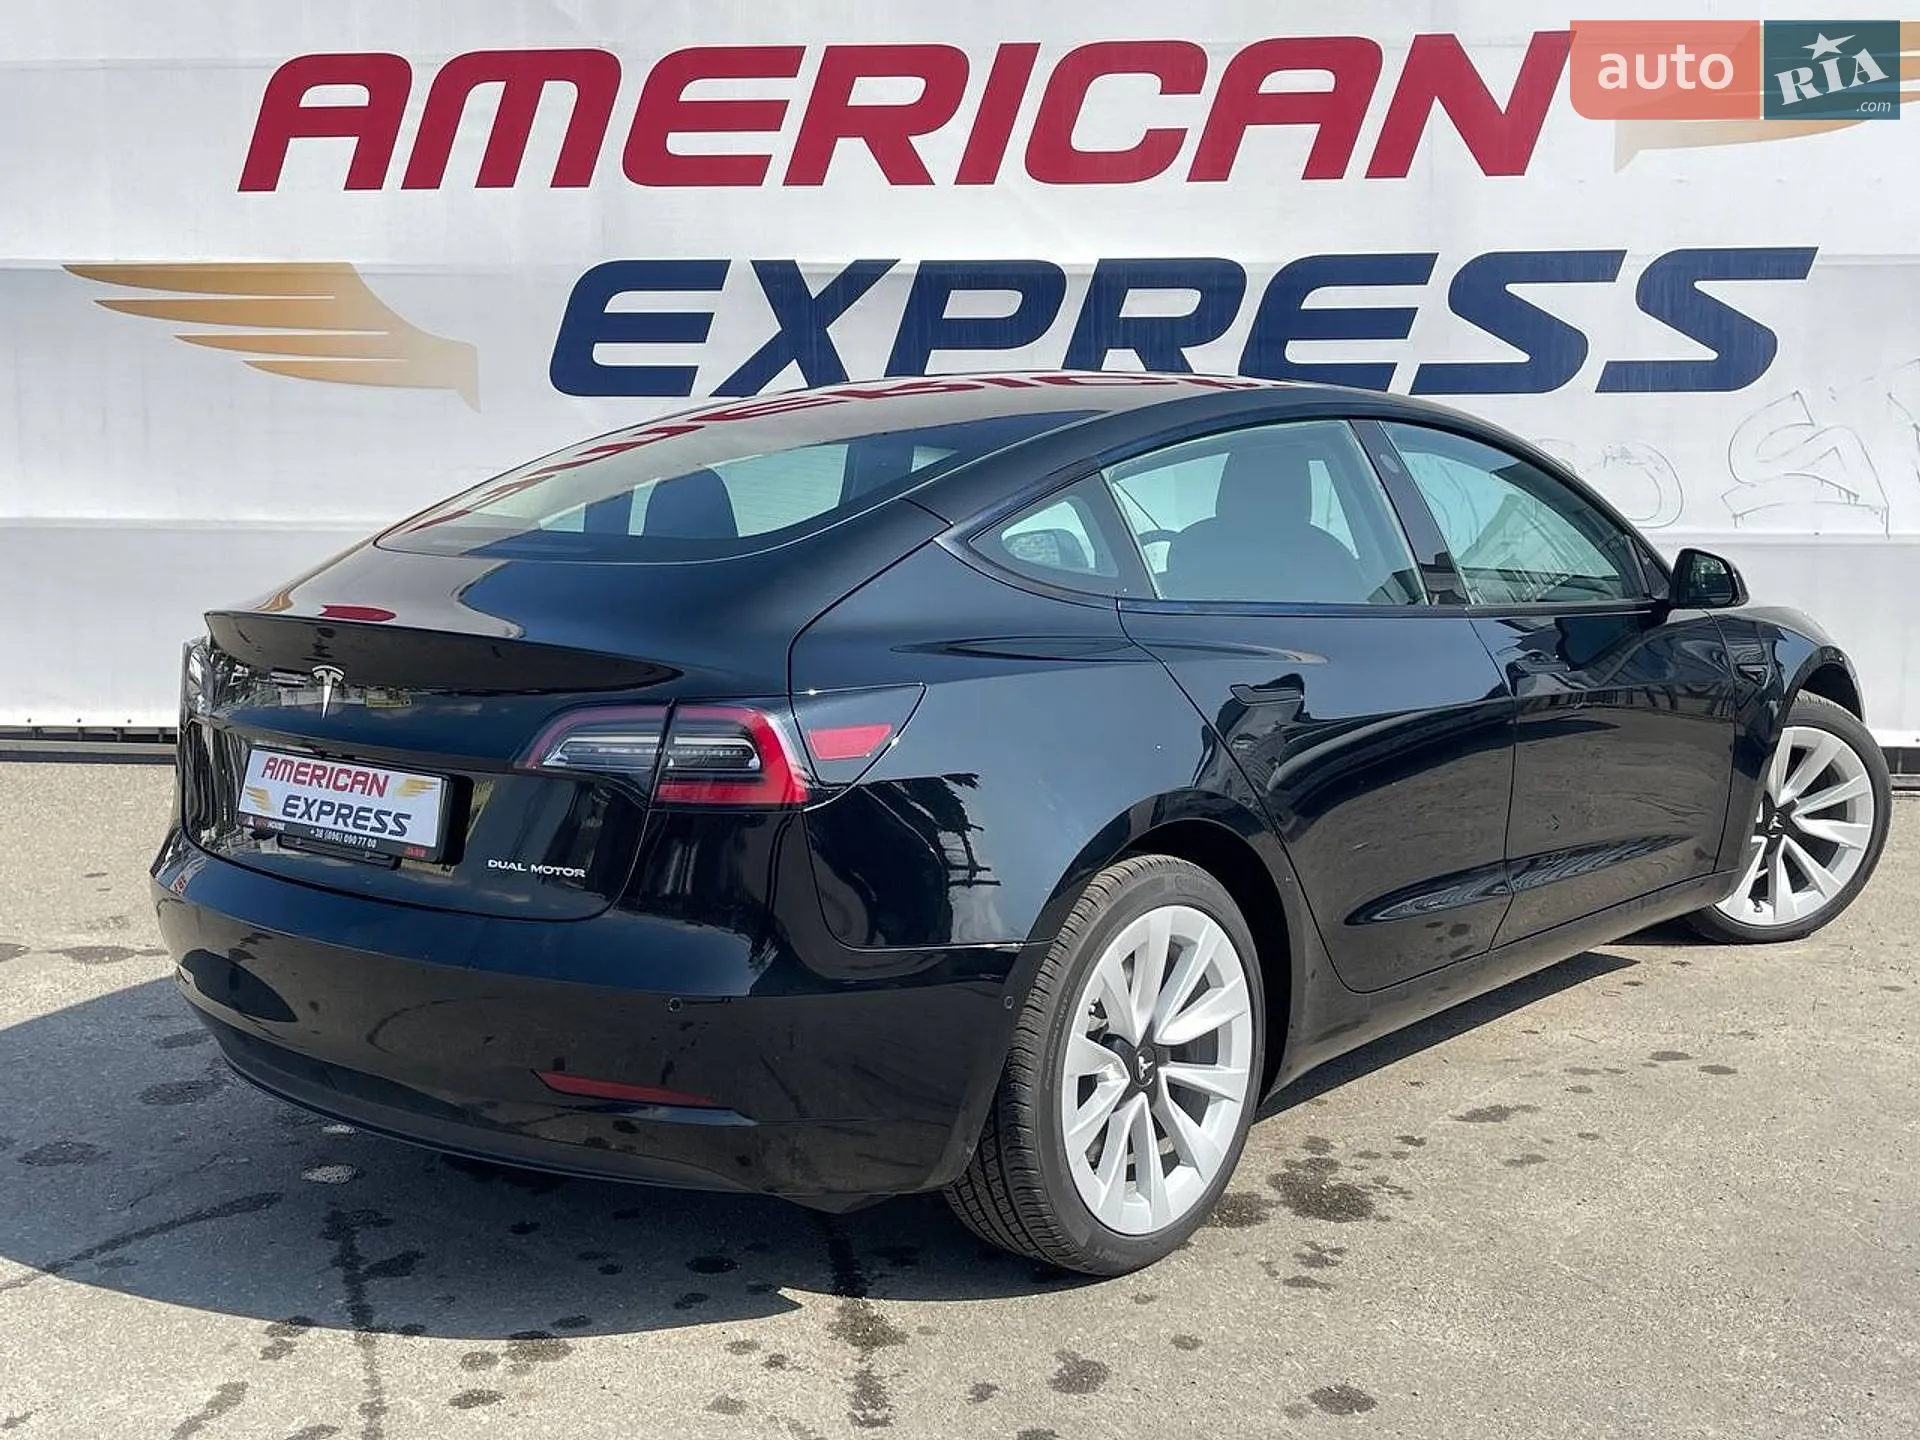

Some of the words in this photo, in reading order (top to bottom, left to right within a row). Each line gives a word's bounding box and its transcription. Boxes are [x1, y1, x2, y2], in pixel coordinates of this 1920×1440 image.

[240, 31, 1577, 193] AMERICAN
[549, 247, 1816, 398] EXPRESS
[261, 756, 390, 798] AMERICAN
[282, 794, 412, 837] EXPRESS
[487, 859, 527, 872] DUAL
[530, 864, 586, 878] MOTOR
